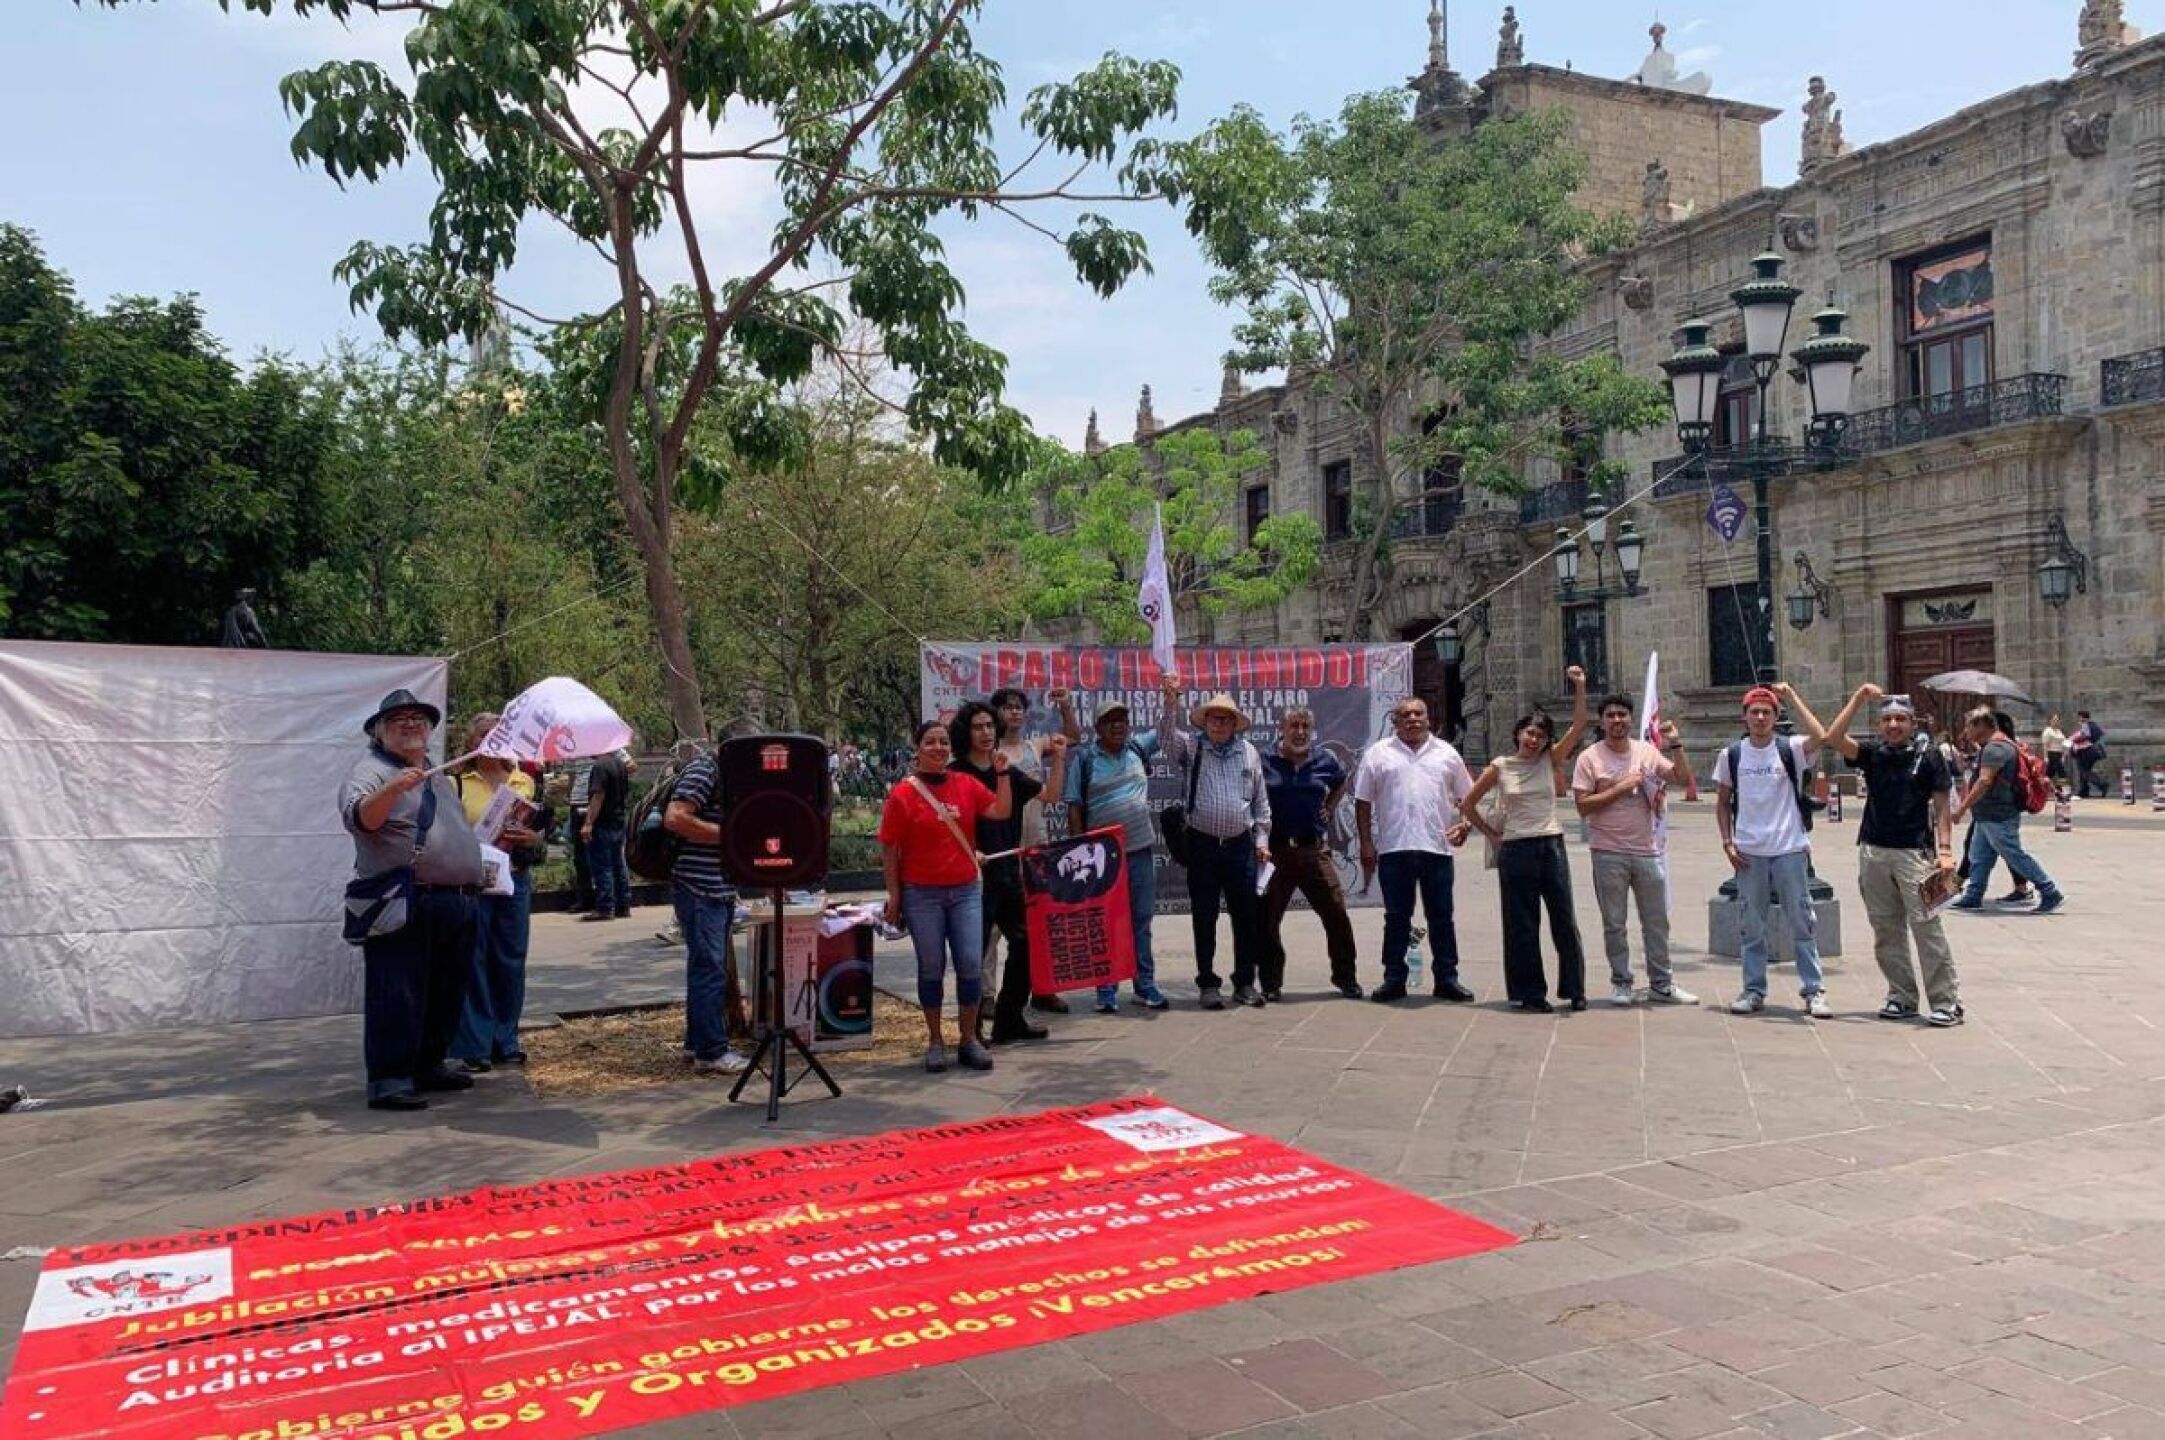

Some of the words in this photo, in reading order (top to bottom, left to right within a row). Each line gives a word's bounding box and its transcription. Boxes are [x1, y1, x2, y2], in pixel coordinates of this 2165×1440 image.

[1240, 690, 1256, 706] EL
[1263, 690, 1308, 706] PARO
[114, 1286, 396, 1340] Jubilación
[414, 1252, 609, 1290] mujeres
[673, 1234, 700, 1248] y
[711, 1201, 903, 1239] hombres
[1059, 1163, 1105, 1182] de
[786, 1229, 958, 1266] equipos
[967, 1202, 1127, 1235] médicos
[1136, 1190, 1184, 1206] de
[401, 1333, 448, 1356] al
[644, 1289, 722, 1316] por
[734, 1277, 799, 1295] los
[810, 1252, 931, 1282] malos
[939, 1224, 1099, 1258] manejos
[1105, 1214, 1152, 1229] de
[1158, 1203, 1214, 1219] sus
[869, 1301, 939, 1321] los
[949, 1264, 1131, 1306] derechos
[1139, 1255, 1181, 1271] se
[563, 1387, 607, 1419] y
[629, 1312, 1018, 1394] Organizados
